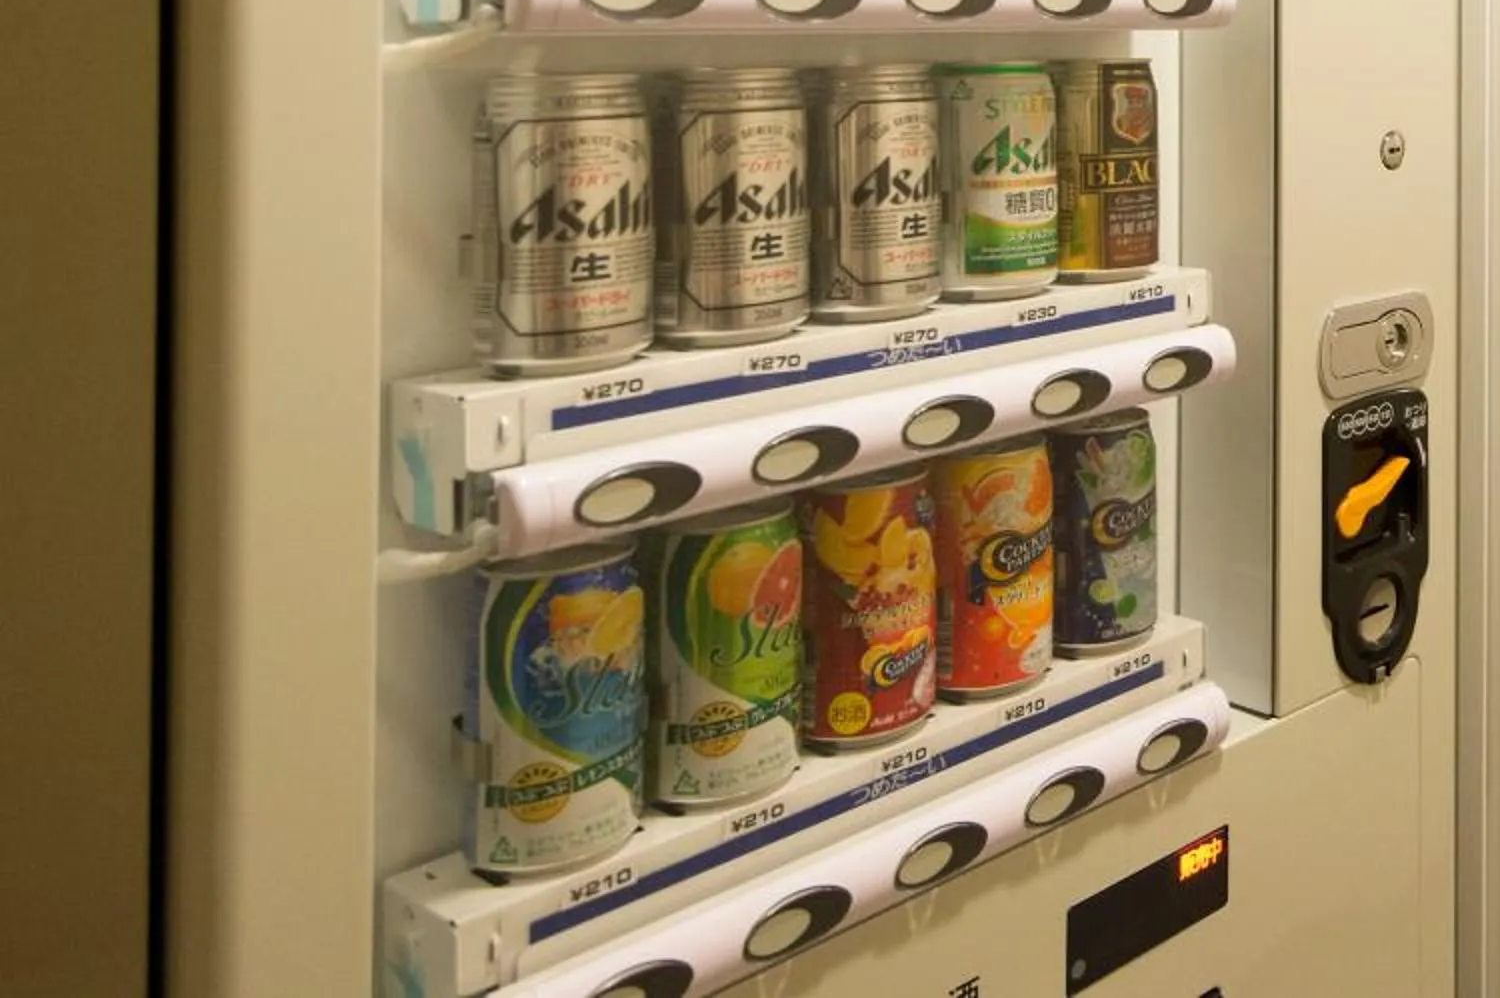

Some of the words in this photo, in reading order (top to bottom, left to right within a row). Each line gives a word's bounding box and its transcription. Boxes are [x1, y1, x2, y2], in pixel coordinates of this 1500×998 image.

[972, 123, 1056, 175] Asa
[853, 155, 940, 208] Asah
[1085, 159, 1153, 187] BLAC
[695, 165, 806, 228] Asah
[902, 212, 929, 240] 生
[751, 233, 785, 261] 生
[570, 251, 612, 283] 生
[1018, 305, 1058, 323] ¥230
[893, 327, 939, 345] ¥270
[749, 354, 802, 371] ¥270
[582, 377, 645, 401] ¥270
[1113, 653, 1151, 677] ¥210
[1004, 698, 1046, 722] ¥210
[881, 746, 928, 772] ¥210
[730, 802, 786, 833] ¥210
[569, 866, 633, 903] ¥210
